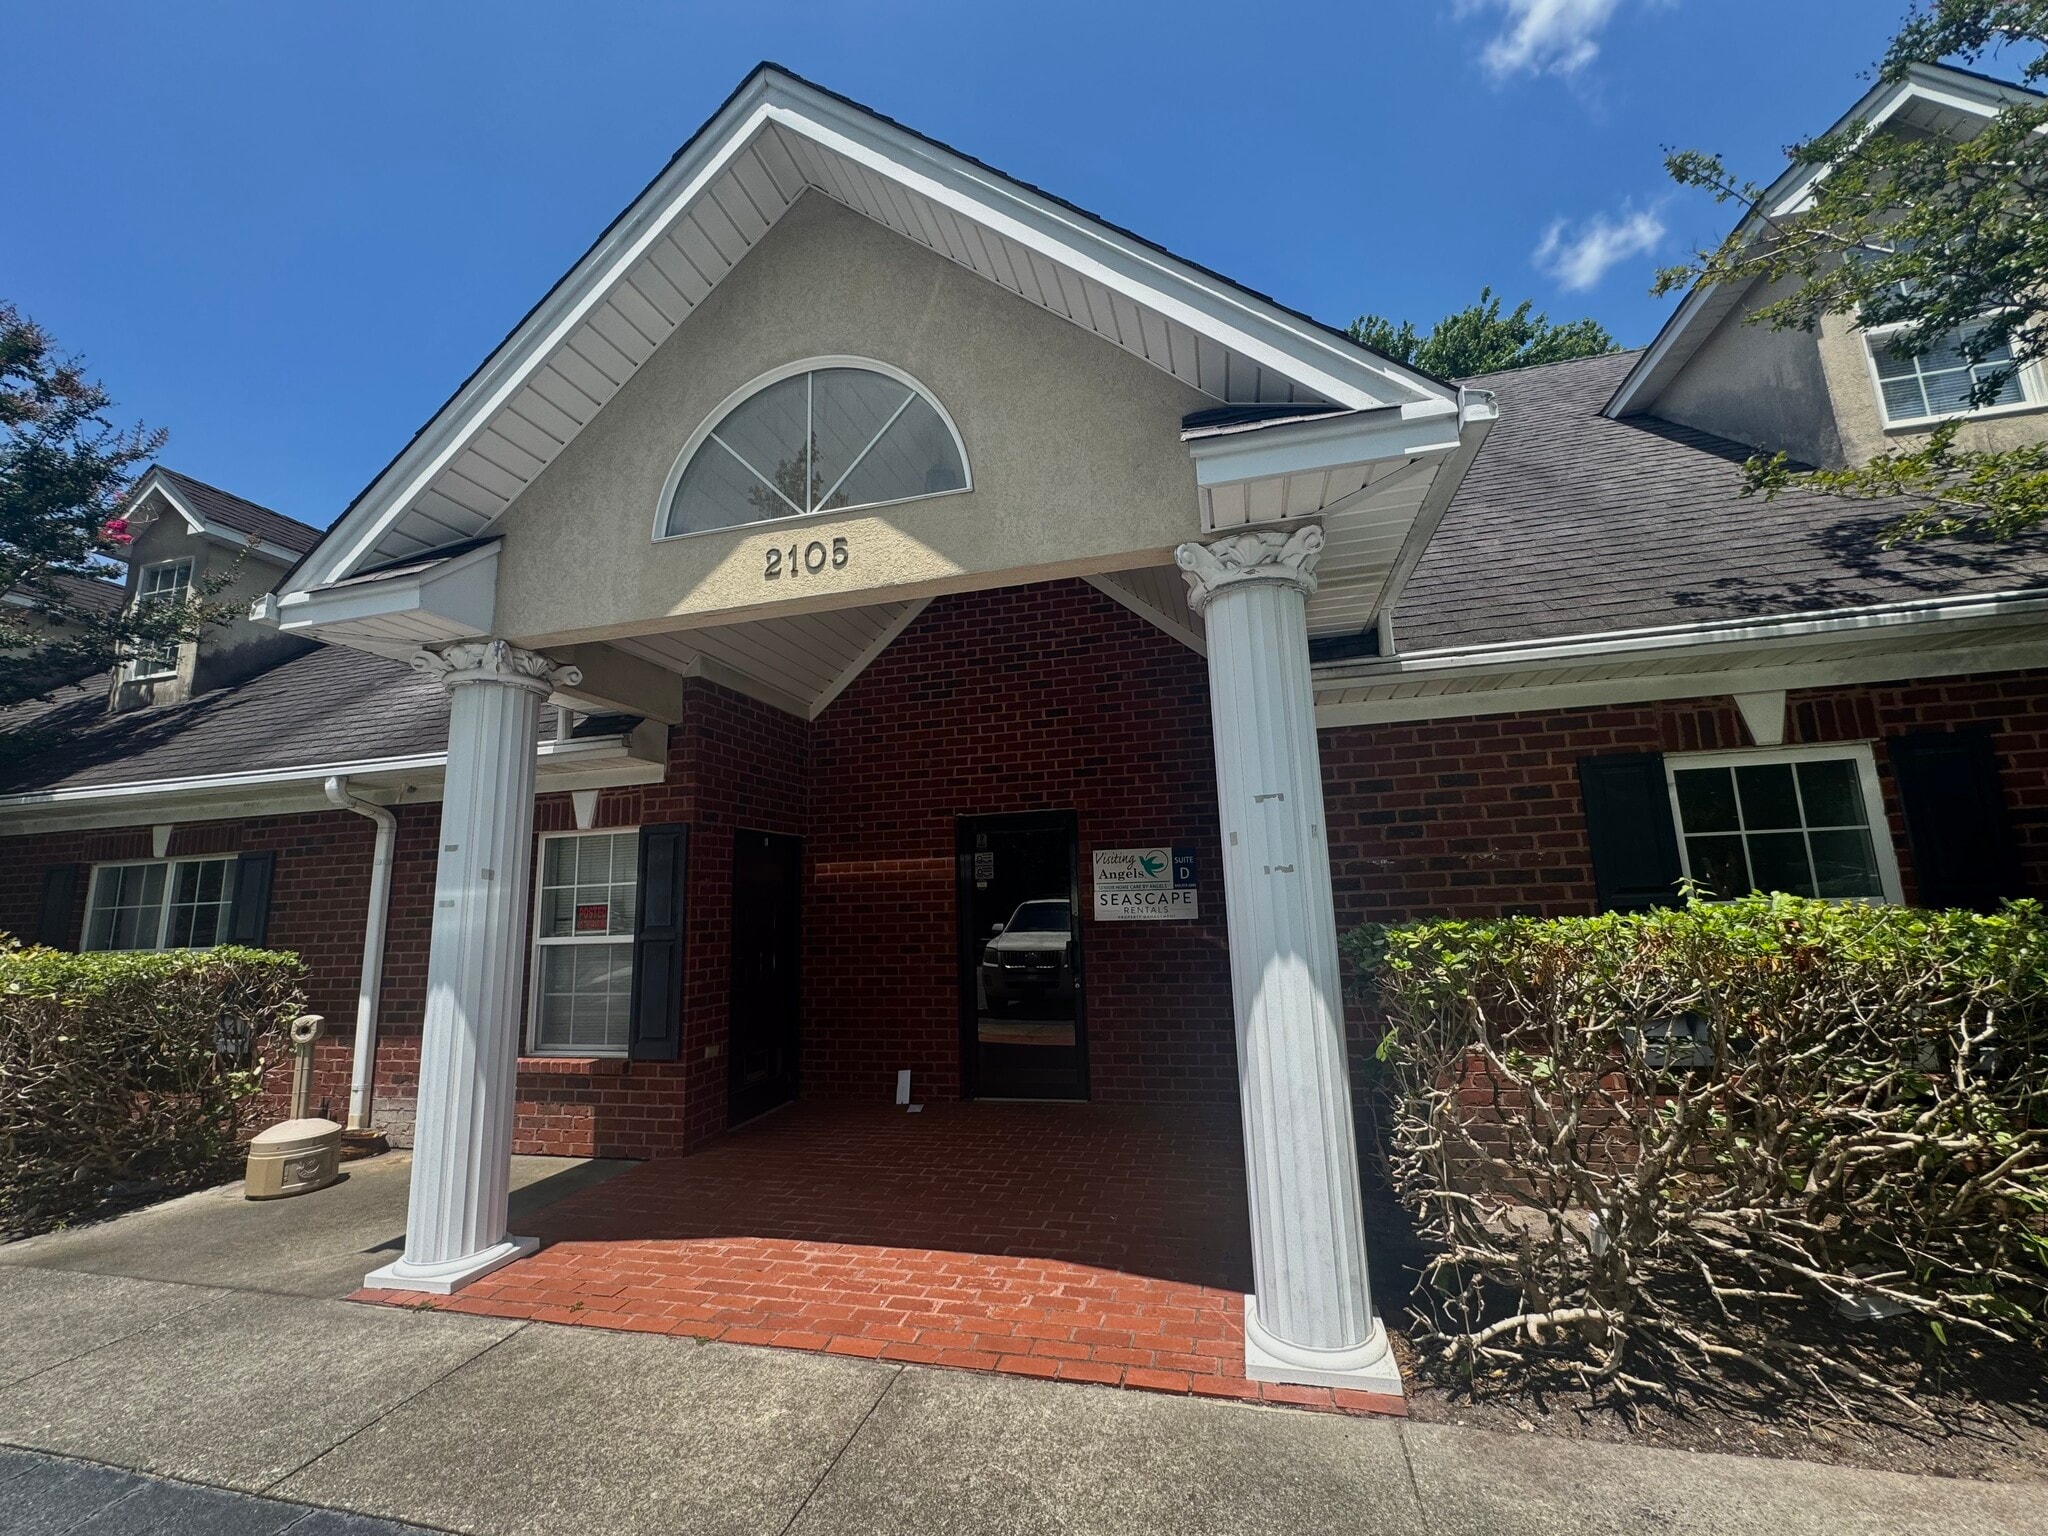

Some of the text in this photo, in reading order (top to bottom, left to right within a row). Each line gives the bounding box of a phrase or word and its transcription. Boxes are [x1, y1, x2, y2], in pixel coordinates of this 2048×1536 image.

[764, 537, 848, 578] 2105
[1095, 852, 1136, 870] Visiting
[1180, 867, 1190, 879] D
[1100, 891, 1192, 906] SEASCAPE
[1123, 905, 1169, 914] RENTALS
